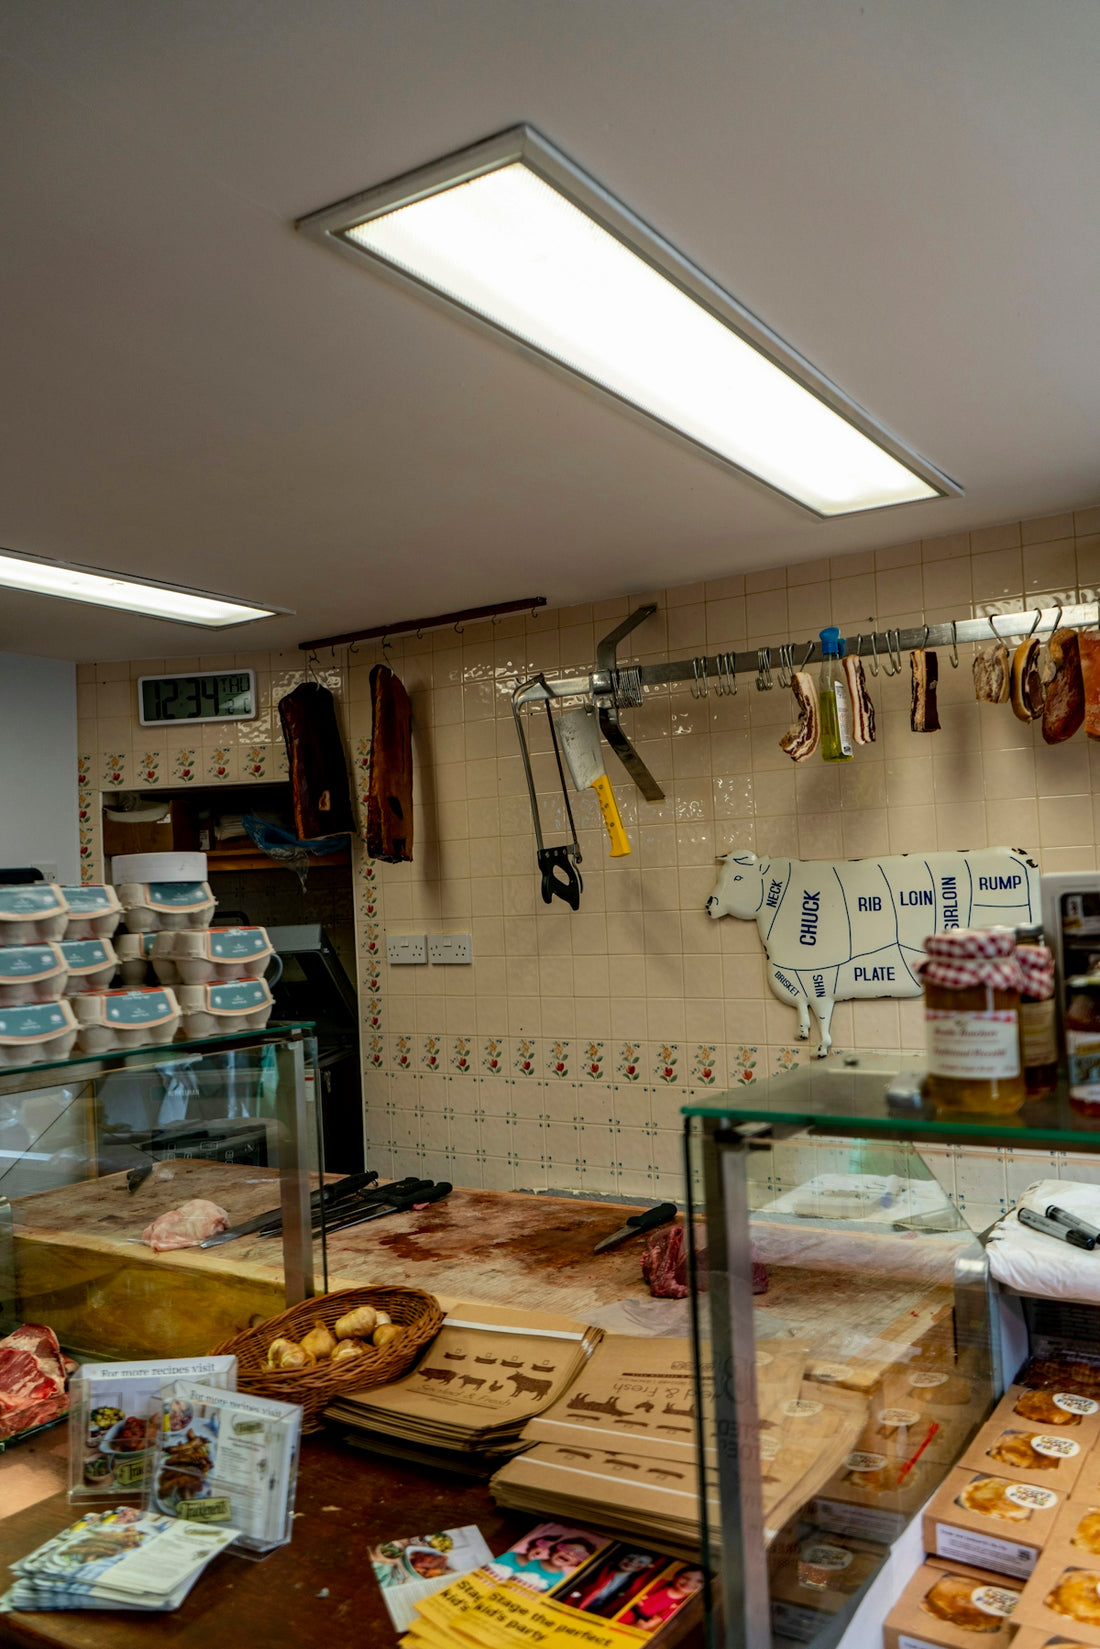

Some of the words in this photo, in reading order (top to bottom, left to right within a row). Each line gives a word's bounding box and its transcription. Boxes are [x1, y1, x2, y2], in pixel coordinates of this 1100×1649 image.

[221, 677, 250, 692] THU
[979, 875, 1022, 891] RUMP
[766, 879, 783, 909] NECK
[900, 890, 933, 906] LOIN
[858, 896, 882, 912] RIB
[800, 890, 821, 946] CHUCK
[854, 966, 896, 982] PLATE
[774, 971, 800, 997] BRISKET
[812, 974, 826, 998] SHIN
[122, 1368, 150, 1377] more
[152, 1365, 190, 1376] recipes
[192, 1363, 215, 1373] visit
[613, 1383, 657, 1400] Fresh
[473, 1601, 507, 1623] kid's
[504, 1619, 548, 1642] party
[487, 1591, 529, 1616] Stage
[531, 1611, 555, 1628] the
[554, 1624, 613, 1647] perfect
